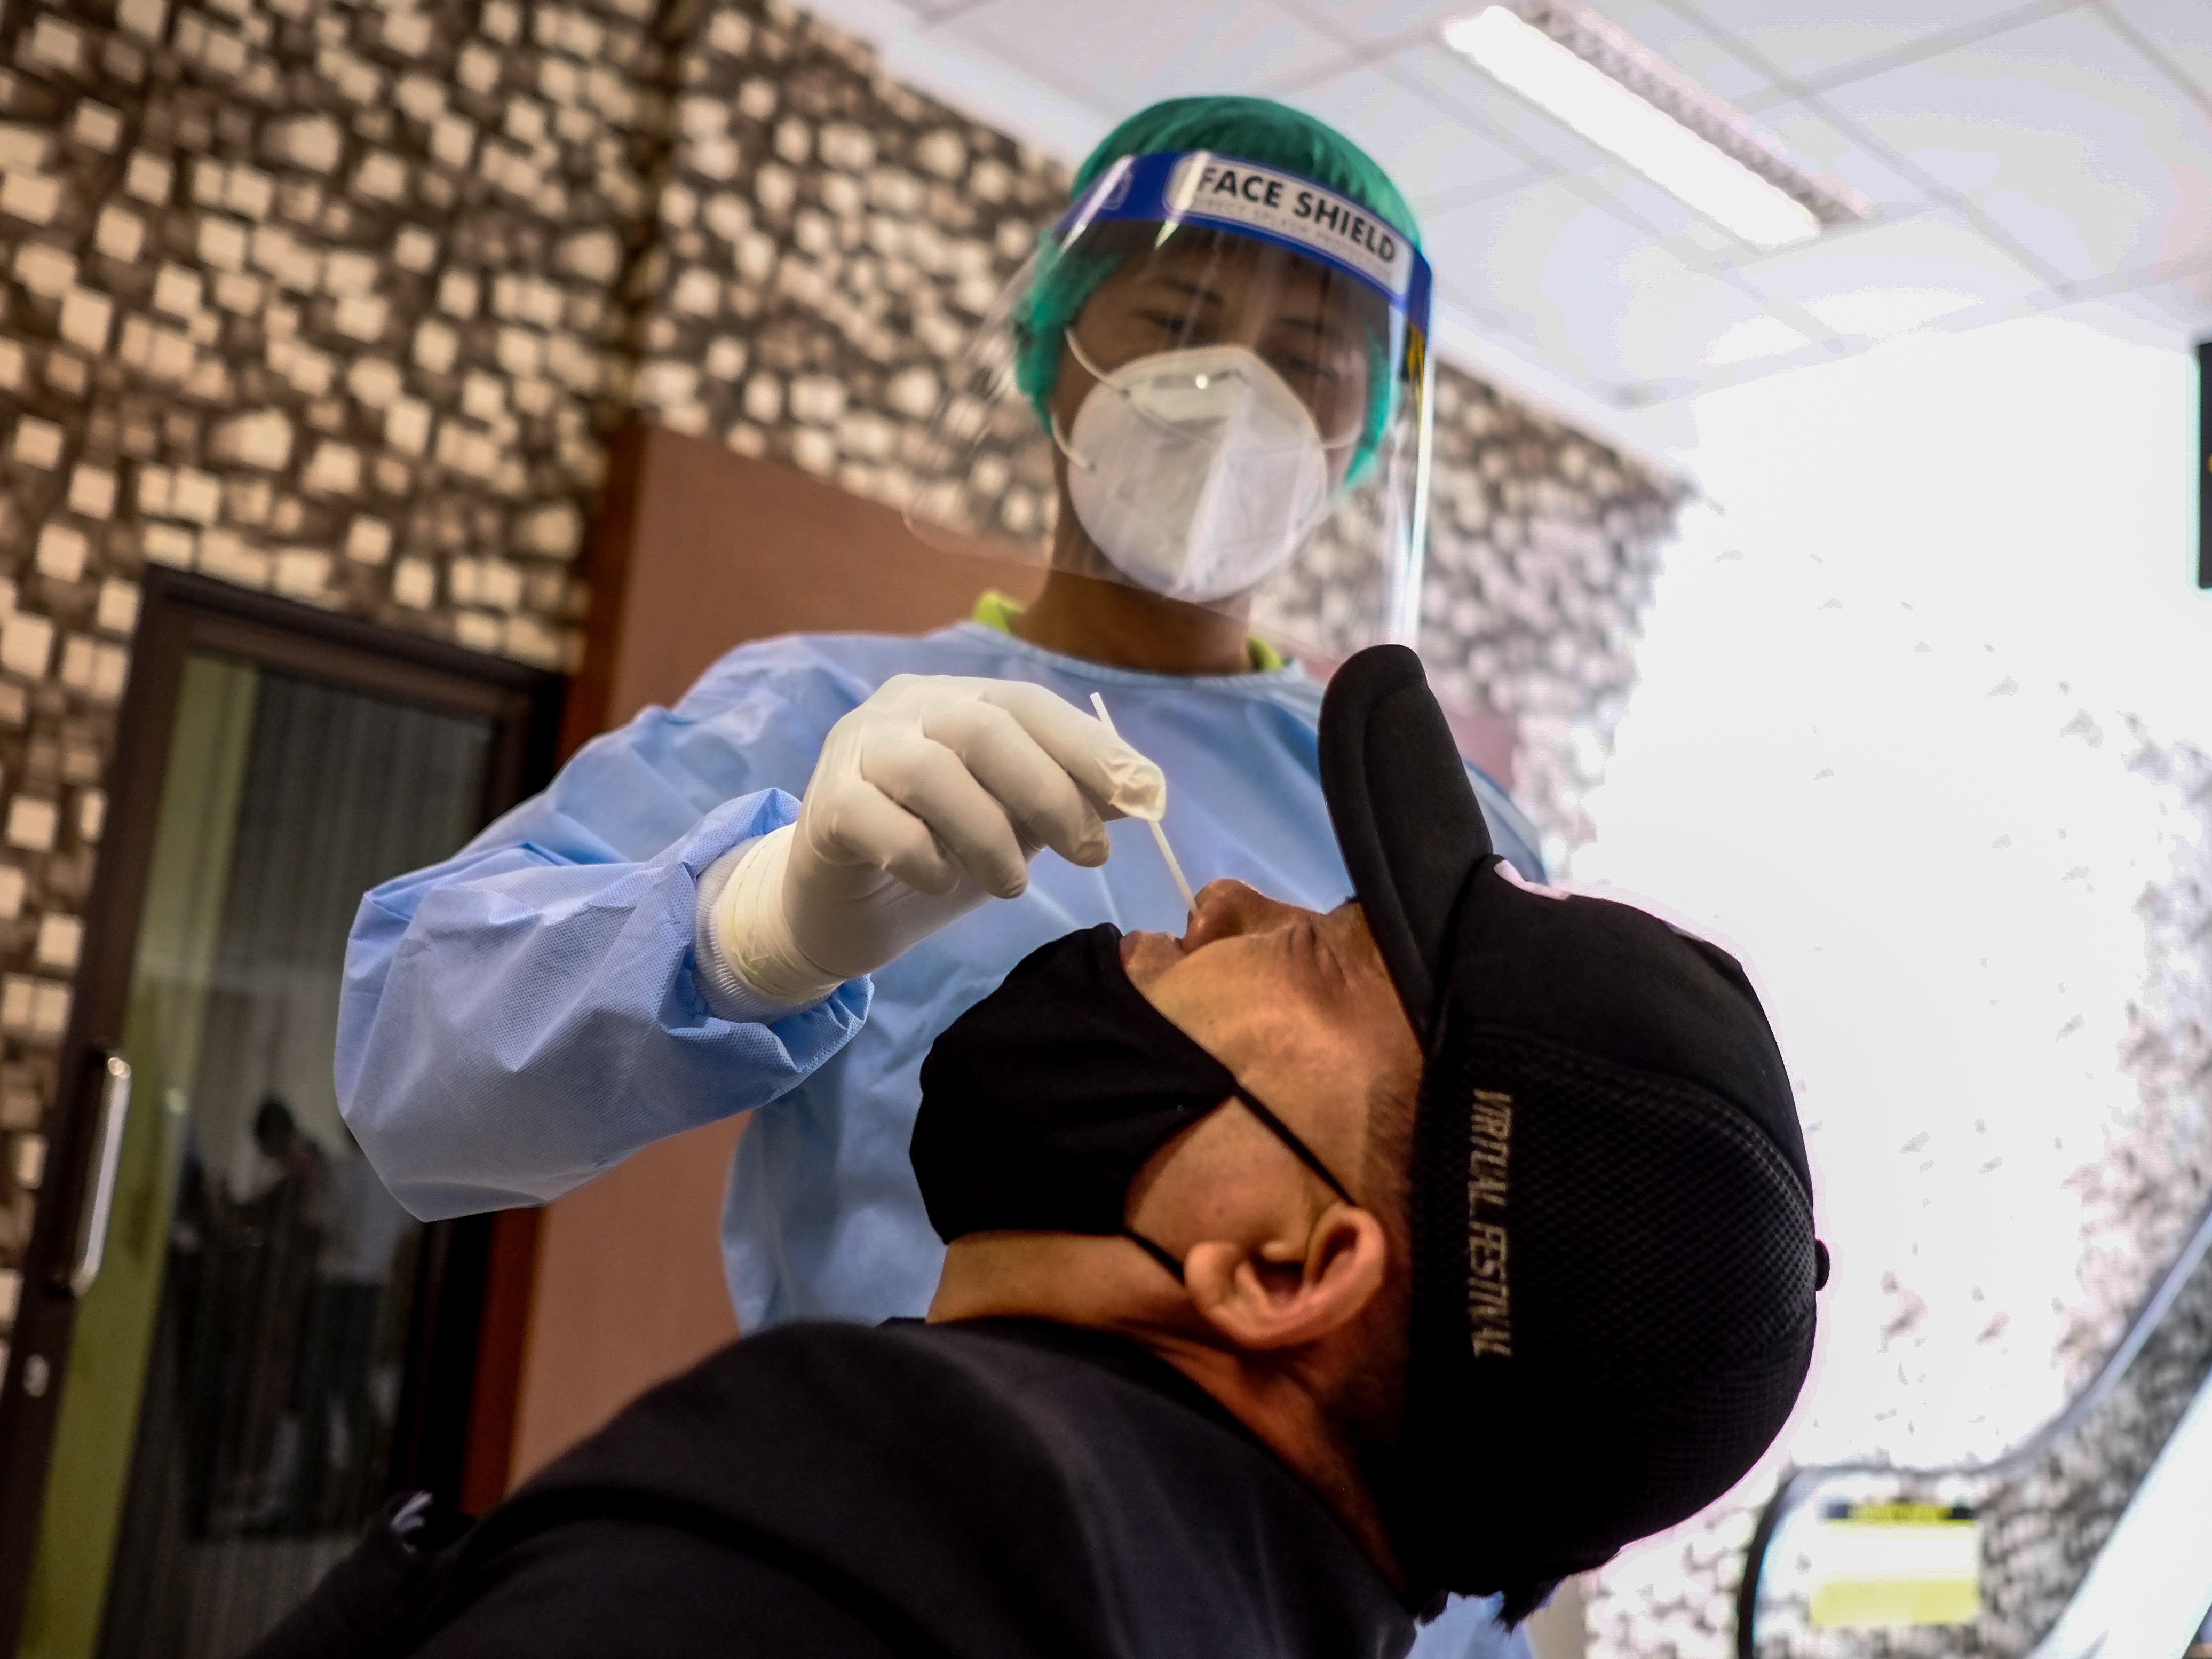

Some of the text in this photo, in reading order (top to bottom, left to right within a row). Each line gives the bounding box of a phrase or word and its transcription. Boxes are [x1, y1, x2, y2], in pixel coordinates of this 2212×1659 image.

[1198, 166, 1282, 209] FACE
[1293, 191, 1396, 263] SHIELD
[1467, 1088, 1512, 1359] VIRTUAL FESTIVAL
